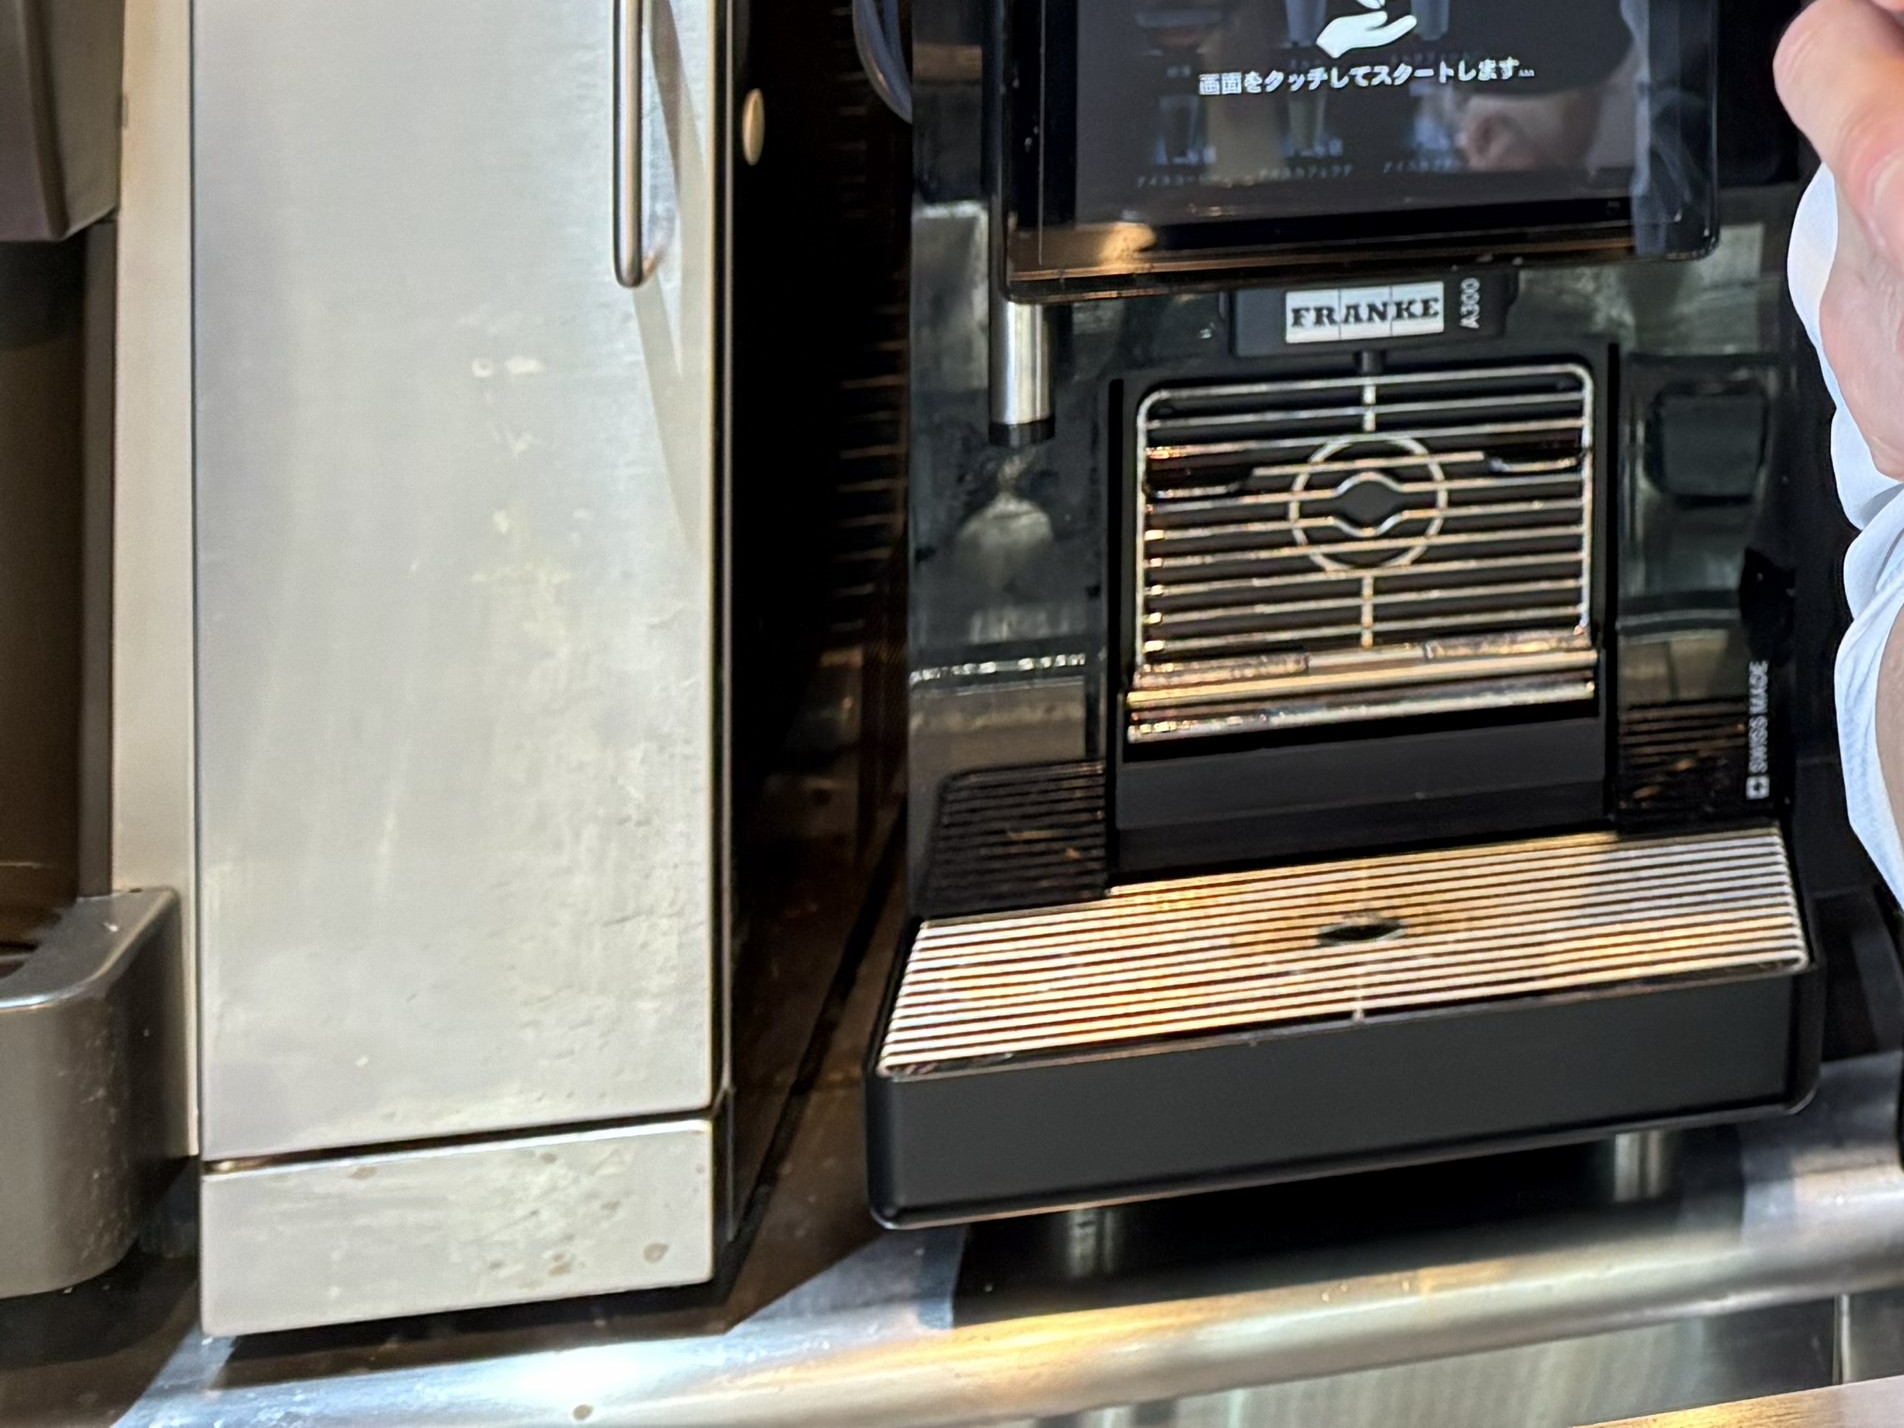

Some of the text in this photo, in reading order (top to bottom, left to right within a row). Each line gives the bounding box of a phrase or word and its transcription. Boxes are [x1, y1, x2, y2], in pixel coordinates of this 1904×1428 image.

[1291, 296, 1440, 329] FRANKE
[1460, 277, 1481, 330] A300
[1748, 660, 1769, 774] SWISS MADE
